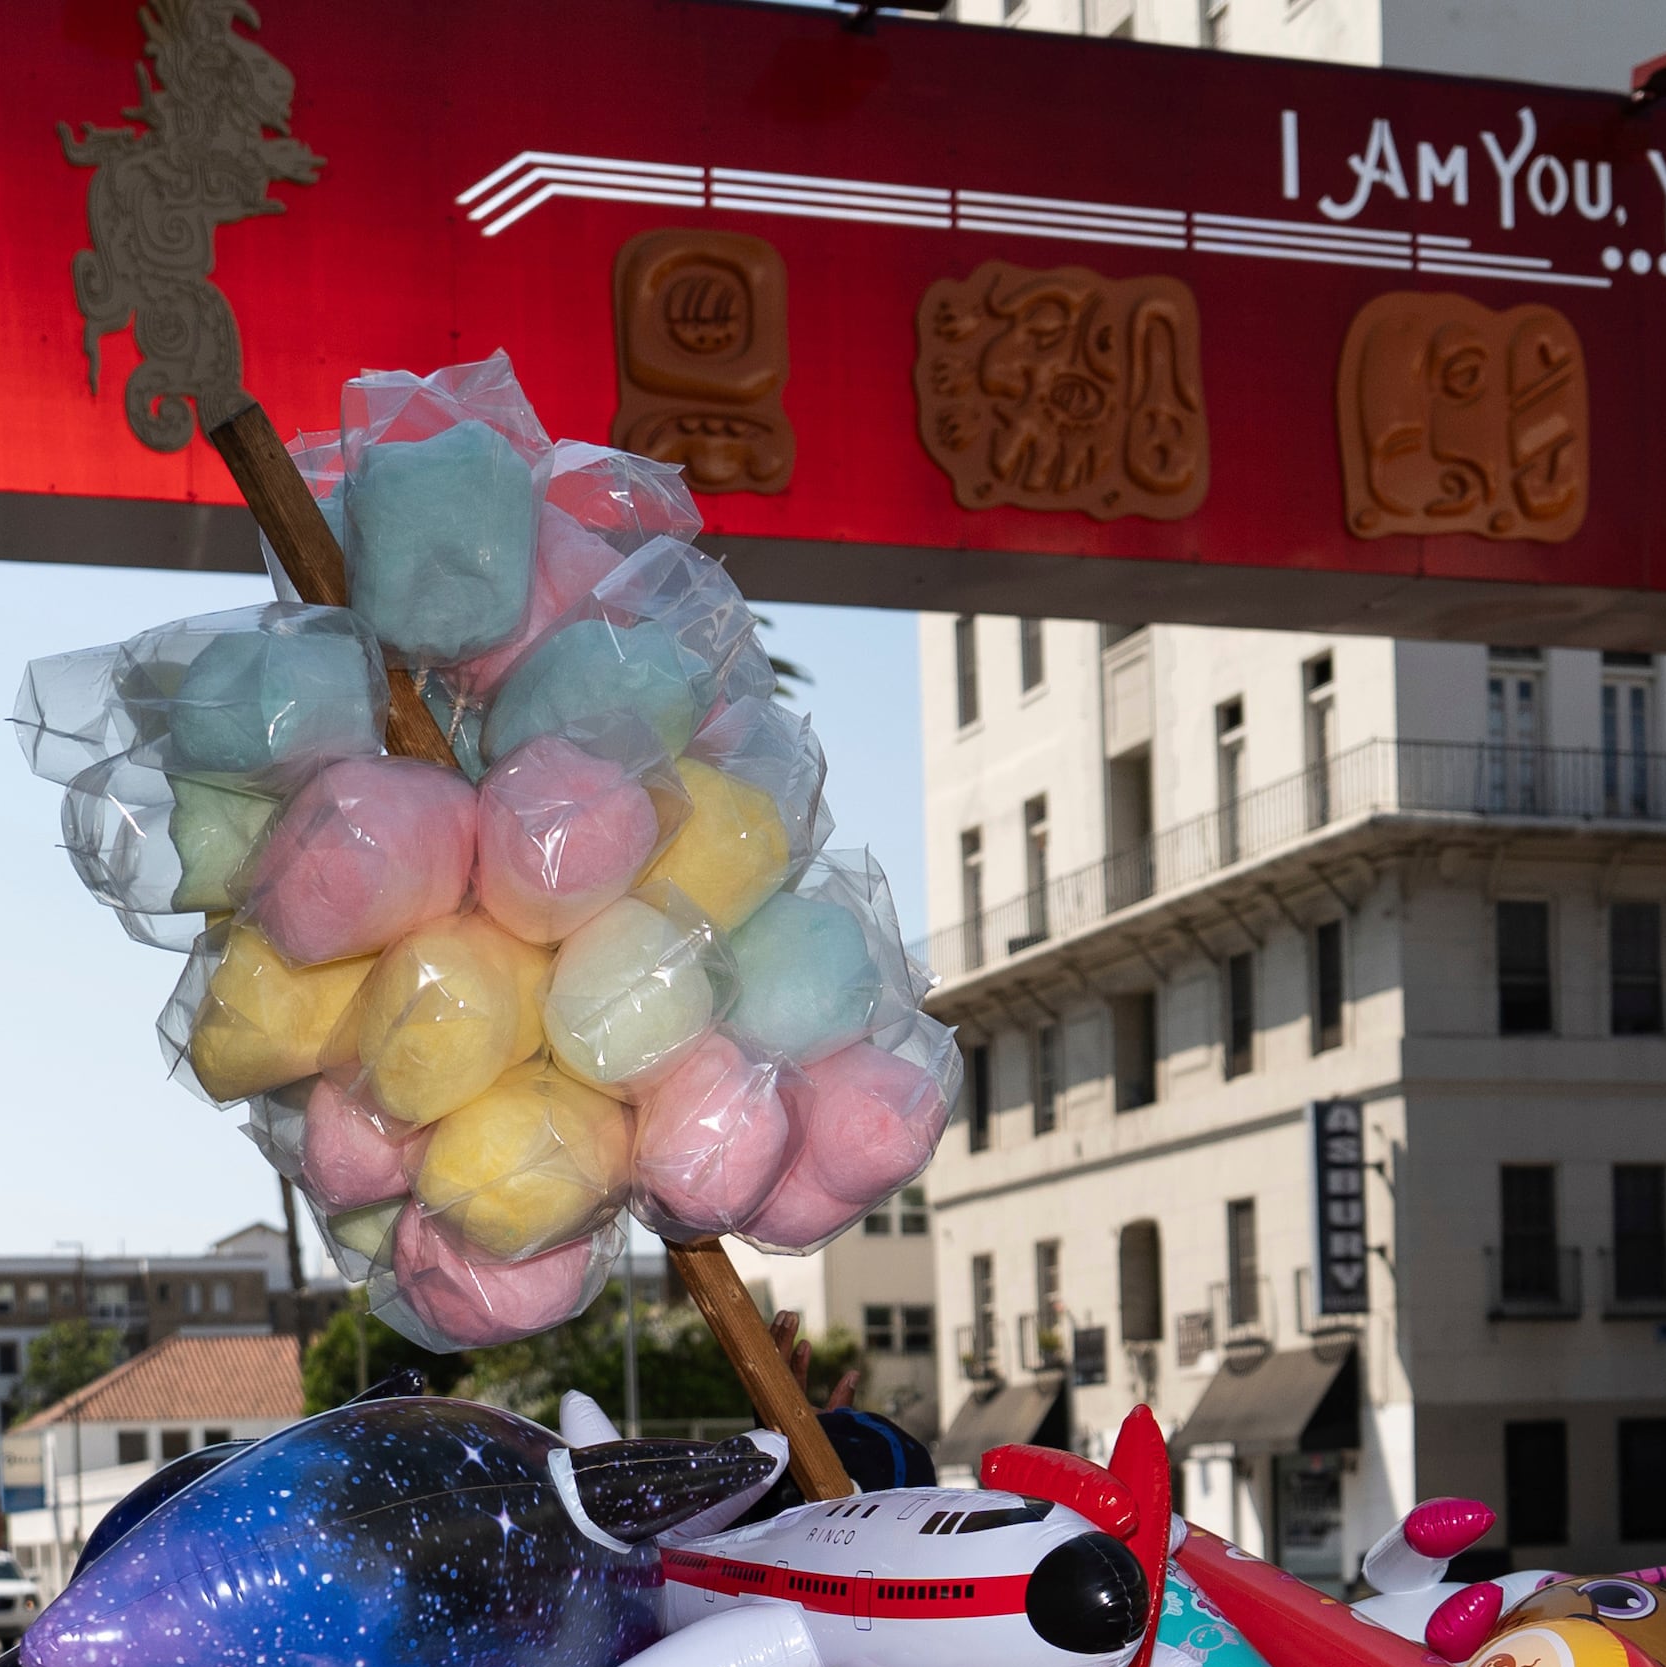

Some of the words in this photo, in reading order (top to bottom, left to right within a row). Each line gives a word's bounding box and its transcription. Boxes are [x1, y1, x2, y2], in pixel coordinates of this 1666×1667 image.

[1279, 108, 1301, 201] I
[1317, 117, 1471, 222] AM
[1480, 107, 1629, 231] YOU,
[1324, 1103, 1364, 1289] ASBURY
[805, 1526, 856, 1546] RINCO
